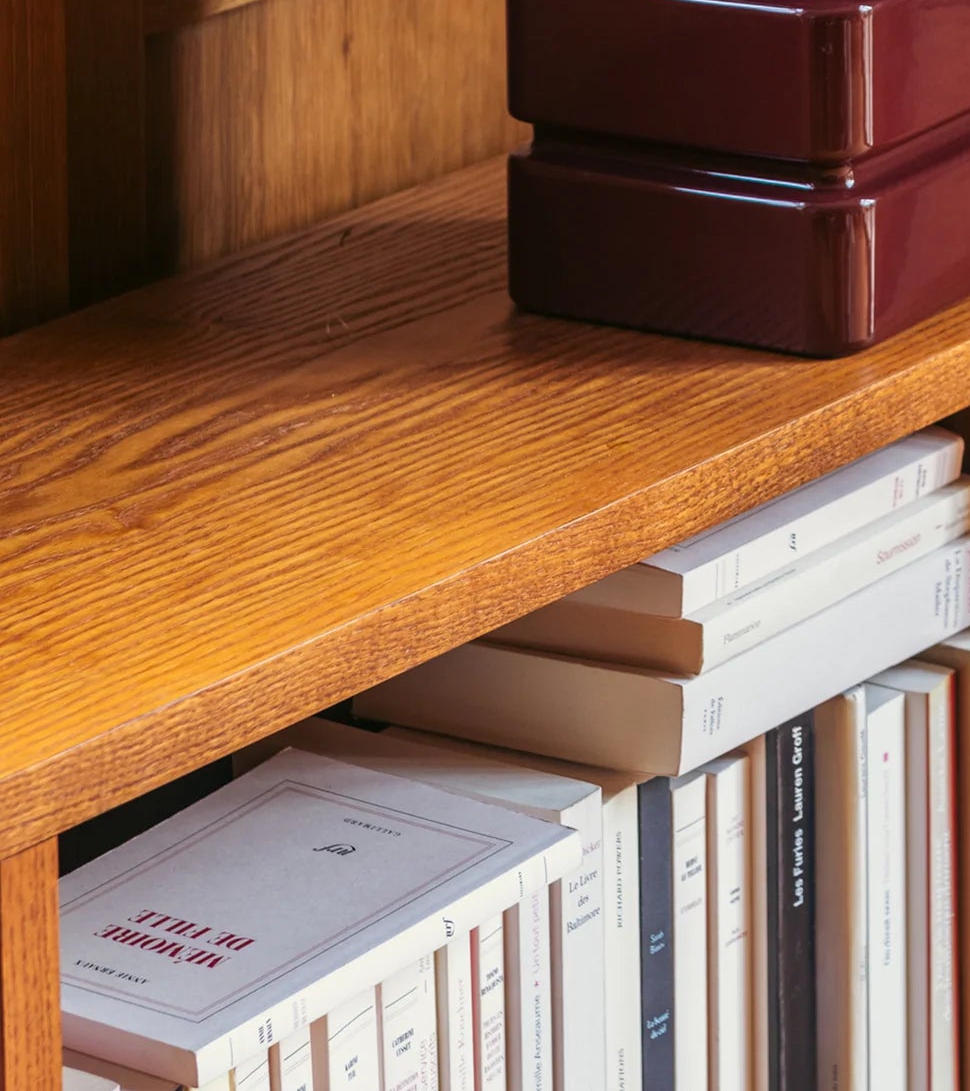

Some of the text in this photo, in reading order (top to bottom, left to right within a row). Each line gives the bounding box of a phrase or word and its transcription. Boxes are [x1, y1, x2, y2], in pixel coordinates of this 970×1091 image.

[343, 817, 401, 837] GALLIMARD
[791, 726, 804, 907] Les Furies Lauren Groff
[582, 839, 601, 857] icker
[568, 869, 598, 894] Le Livre
[577, 893, 590, 908] des
[128, 909, 256, 952] DE FILLE
[443, 917, 455, 938] nrf
[566, 907, 601, 934] Baltimore
[93, 924, 232, 969] MÉMOIRE
[74, 959, 150, 985] ANNIE ERNAUX
[532, 893, 543, 1091] mille Anseaume Un tout petit
